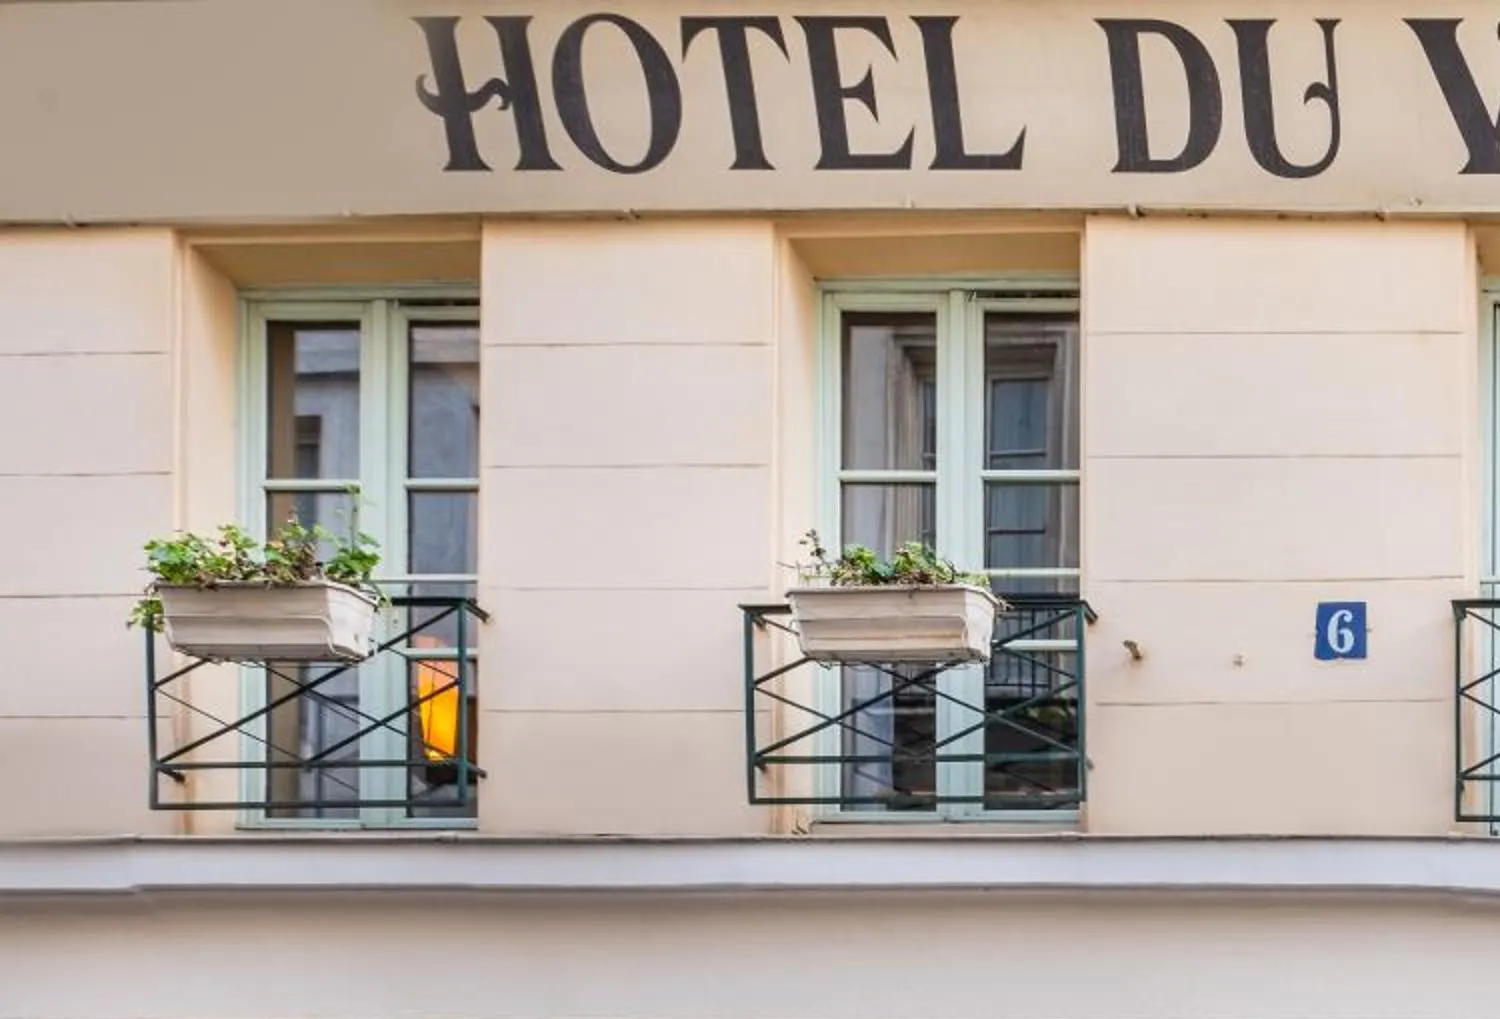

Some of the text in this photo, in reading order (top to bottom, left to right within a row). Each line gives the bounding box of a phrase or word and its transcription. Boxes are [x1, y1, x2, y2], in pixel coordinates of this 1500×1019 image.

[411, 13, 1027, 174] HOTEL
[1092, 18, 1342, 179] DU
[1327, 609, 1355, 653] 6
